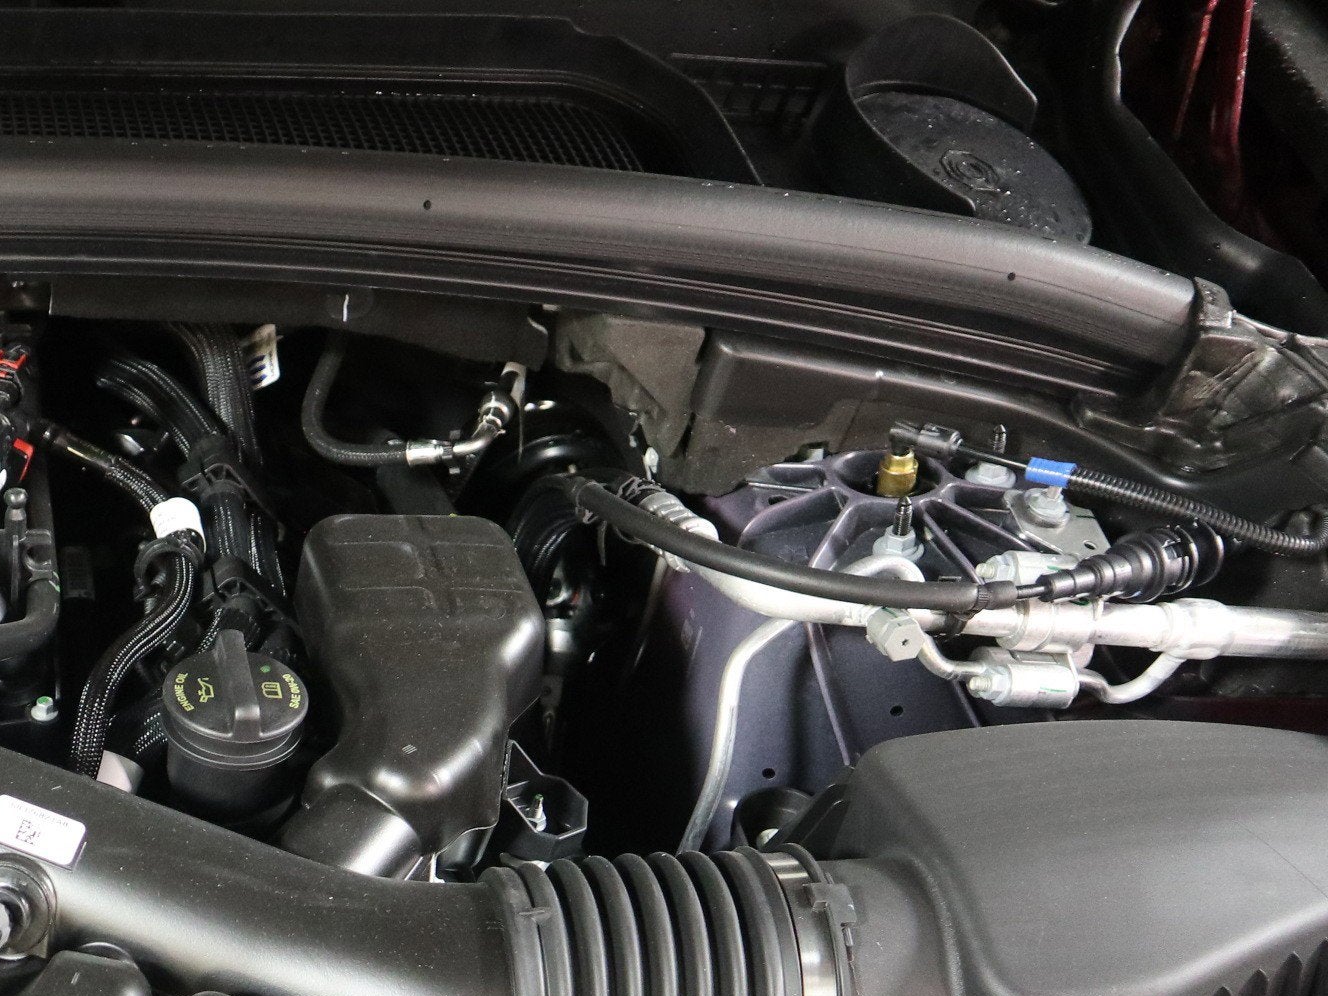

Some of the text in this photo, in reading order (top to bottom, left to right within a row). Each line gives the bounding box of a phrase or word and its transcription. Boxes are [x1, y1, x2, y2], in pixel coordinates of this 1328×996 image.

[174, 672, 195, 712] ENGINE OIL
[288, 694, 301, 710] SAE
